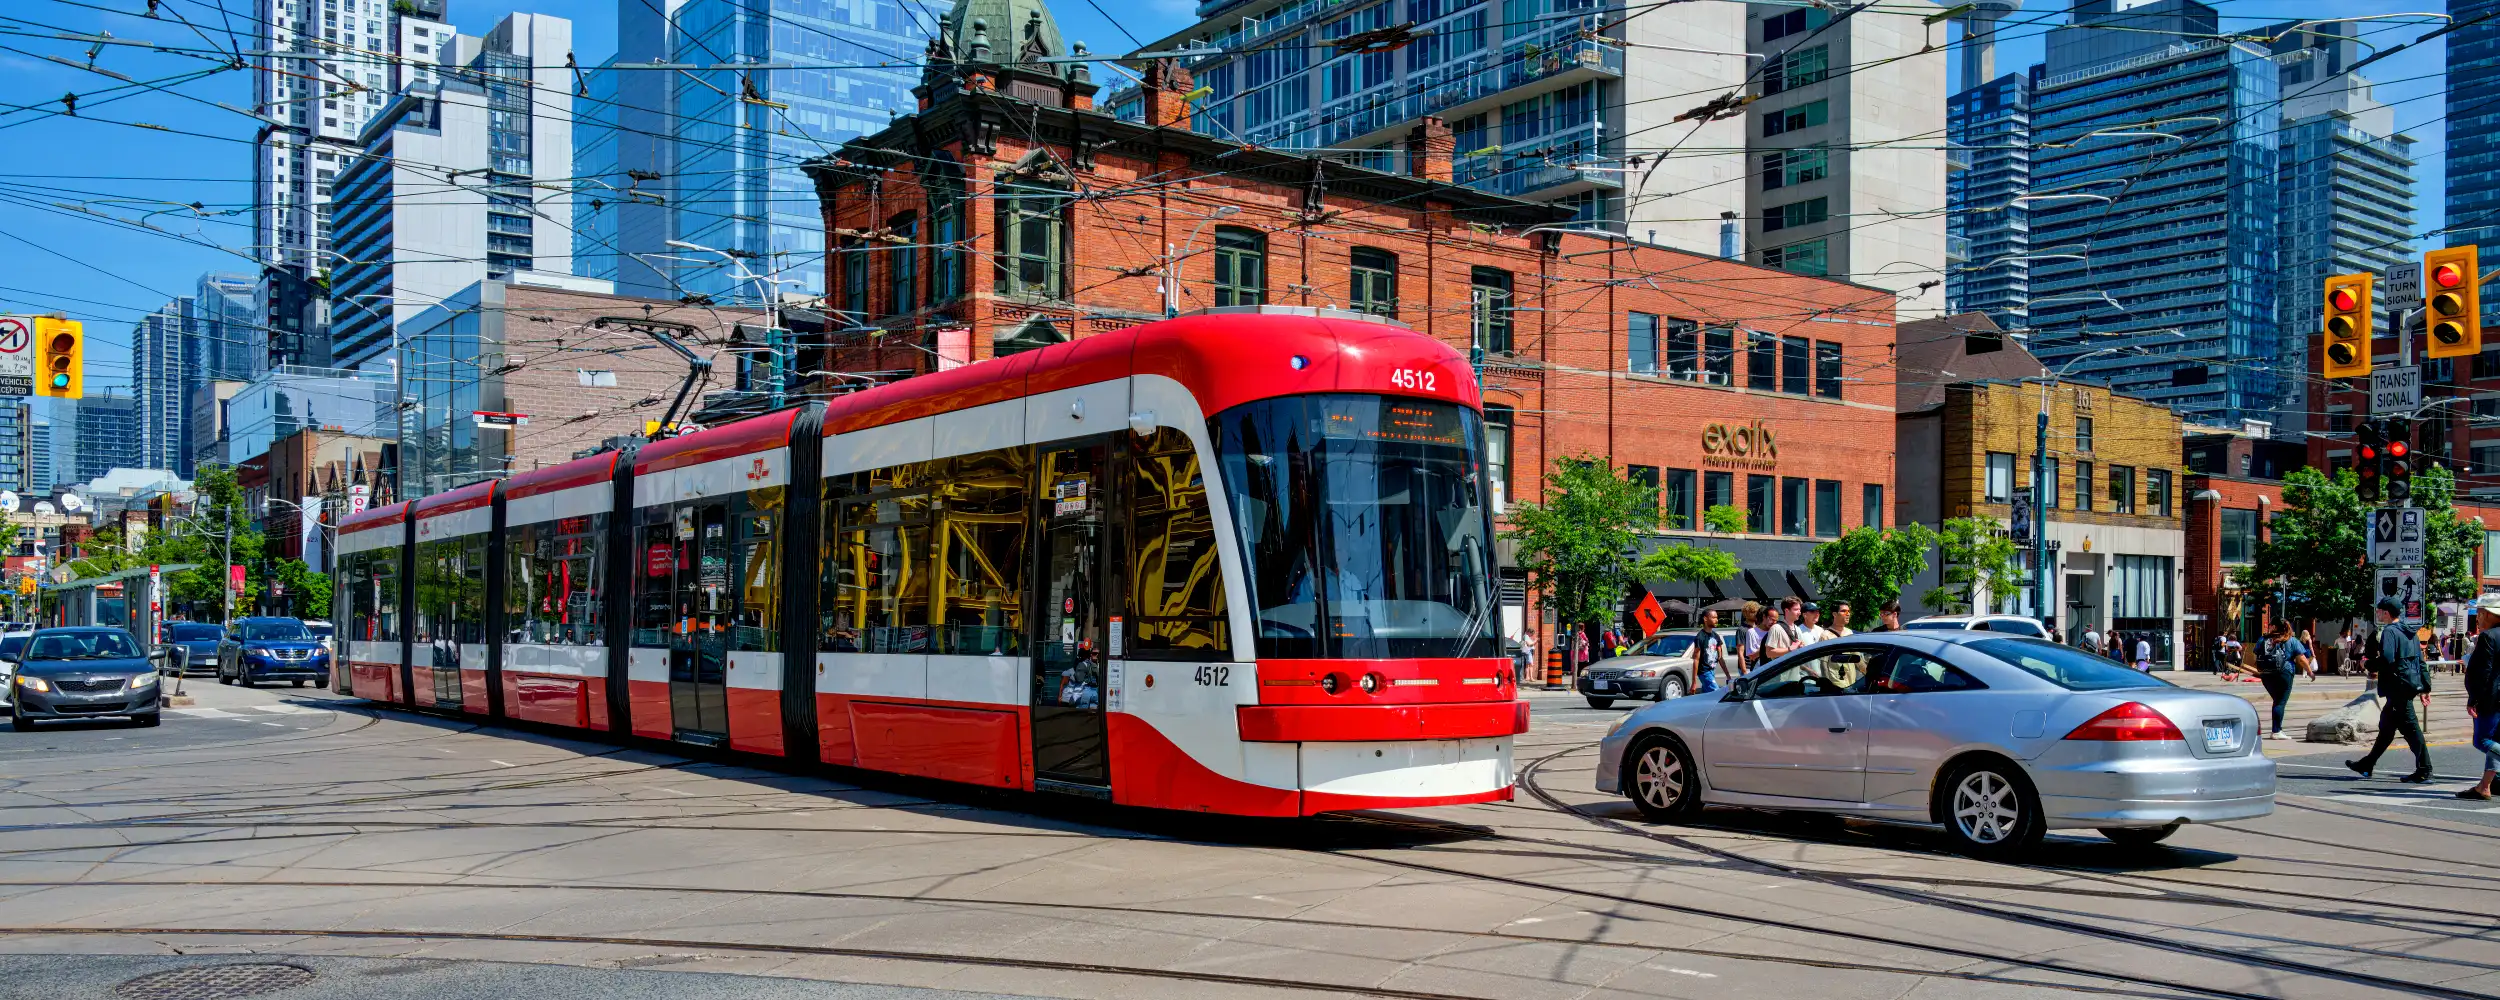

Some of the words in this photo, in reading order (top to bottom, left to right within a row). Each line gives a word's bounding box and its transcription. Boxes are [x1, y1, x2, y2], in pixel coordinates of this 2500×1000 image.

[2390, 268, 2415, 280] LEFT
[2389, 280, 2417, 293] TURN
[2387, 294, 2419, 306] SIGNAL
[0, 378, 32, 386] VEHICLES
[1391, 368, 1436, 391] 4512
[2374, 371, 2417, 390] TRANSIT
[2076, 388, 2092, 409] 161
[2377, 391, 2413, 408] SIGNAL
[1702, 416, 1779, 456] exotix
[1194, 666, 1229, 686] 4512
